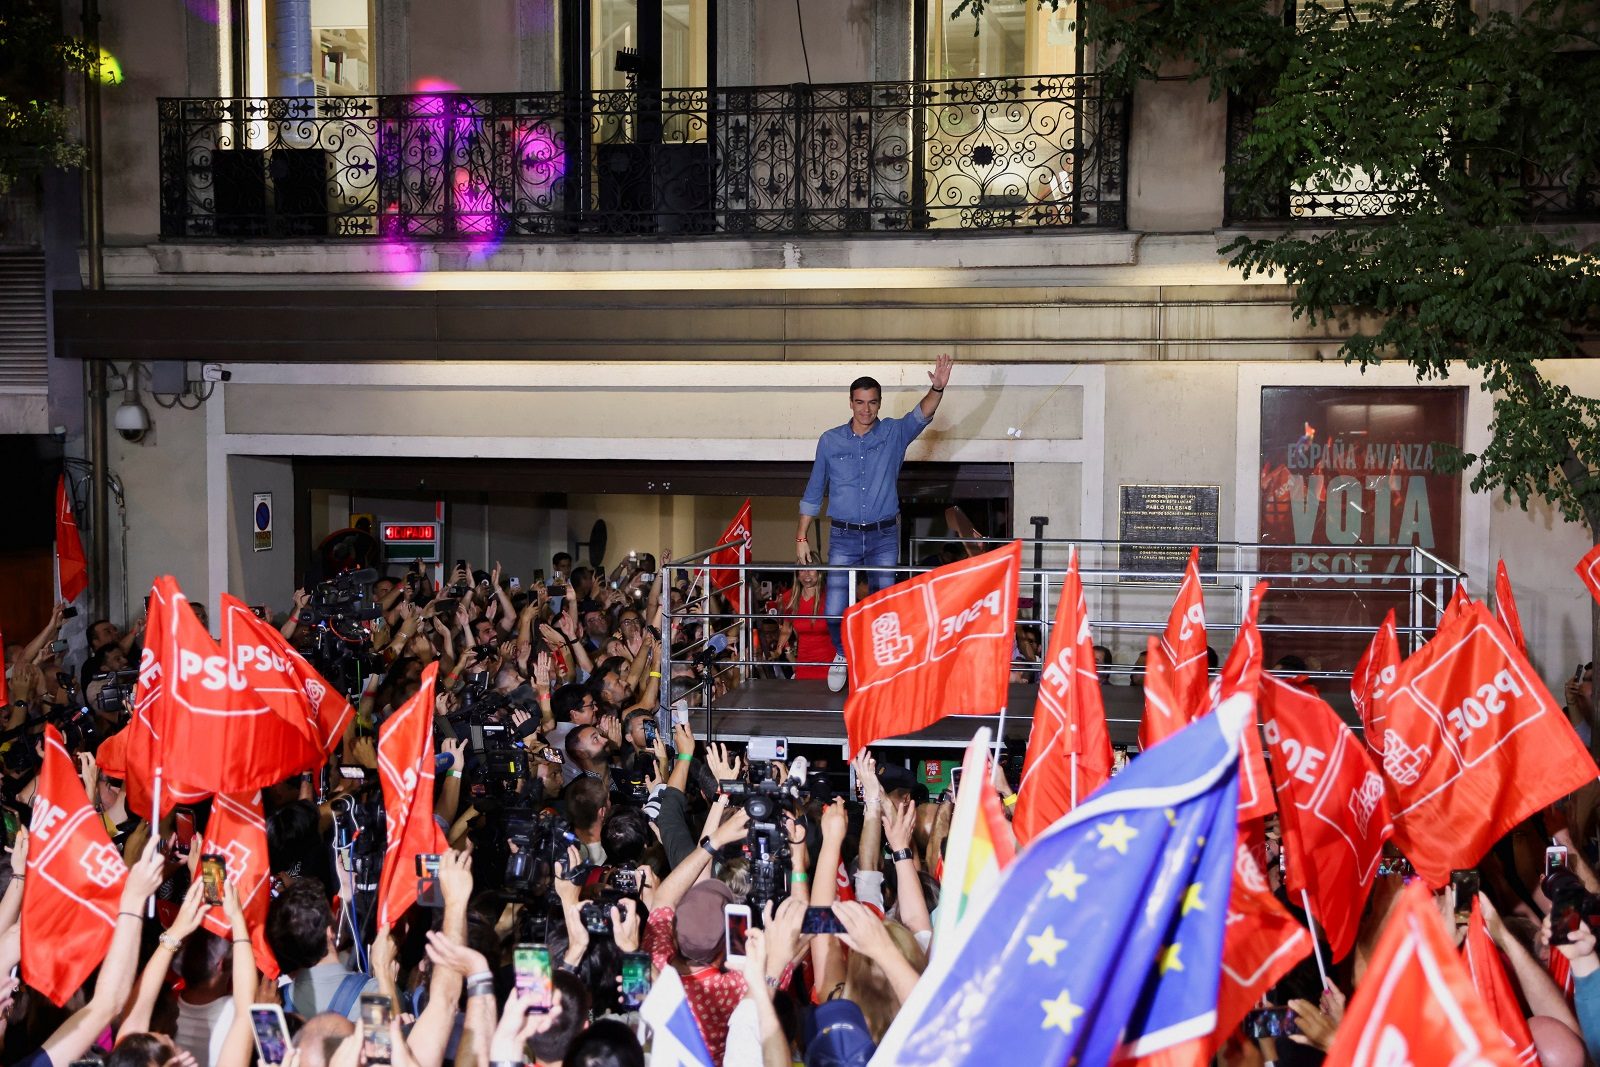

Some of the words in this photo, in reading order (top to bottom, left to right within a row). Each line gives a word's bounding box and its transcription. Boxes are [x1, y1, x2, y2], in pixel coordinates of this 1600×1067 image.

[1287, 439, 1357, 469] ESPAÑA
[1365, 443, 1435, 470] AVANZA
[1290, 475, 1436, 549] VOTA
[387, 526, 432, 539] OCUPADO
[1292, 552, 1373, 584] PSOE
